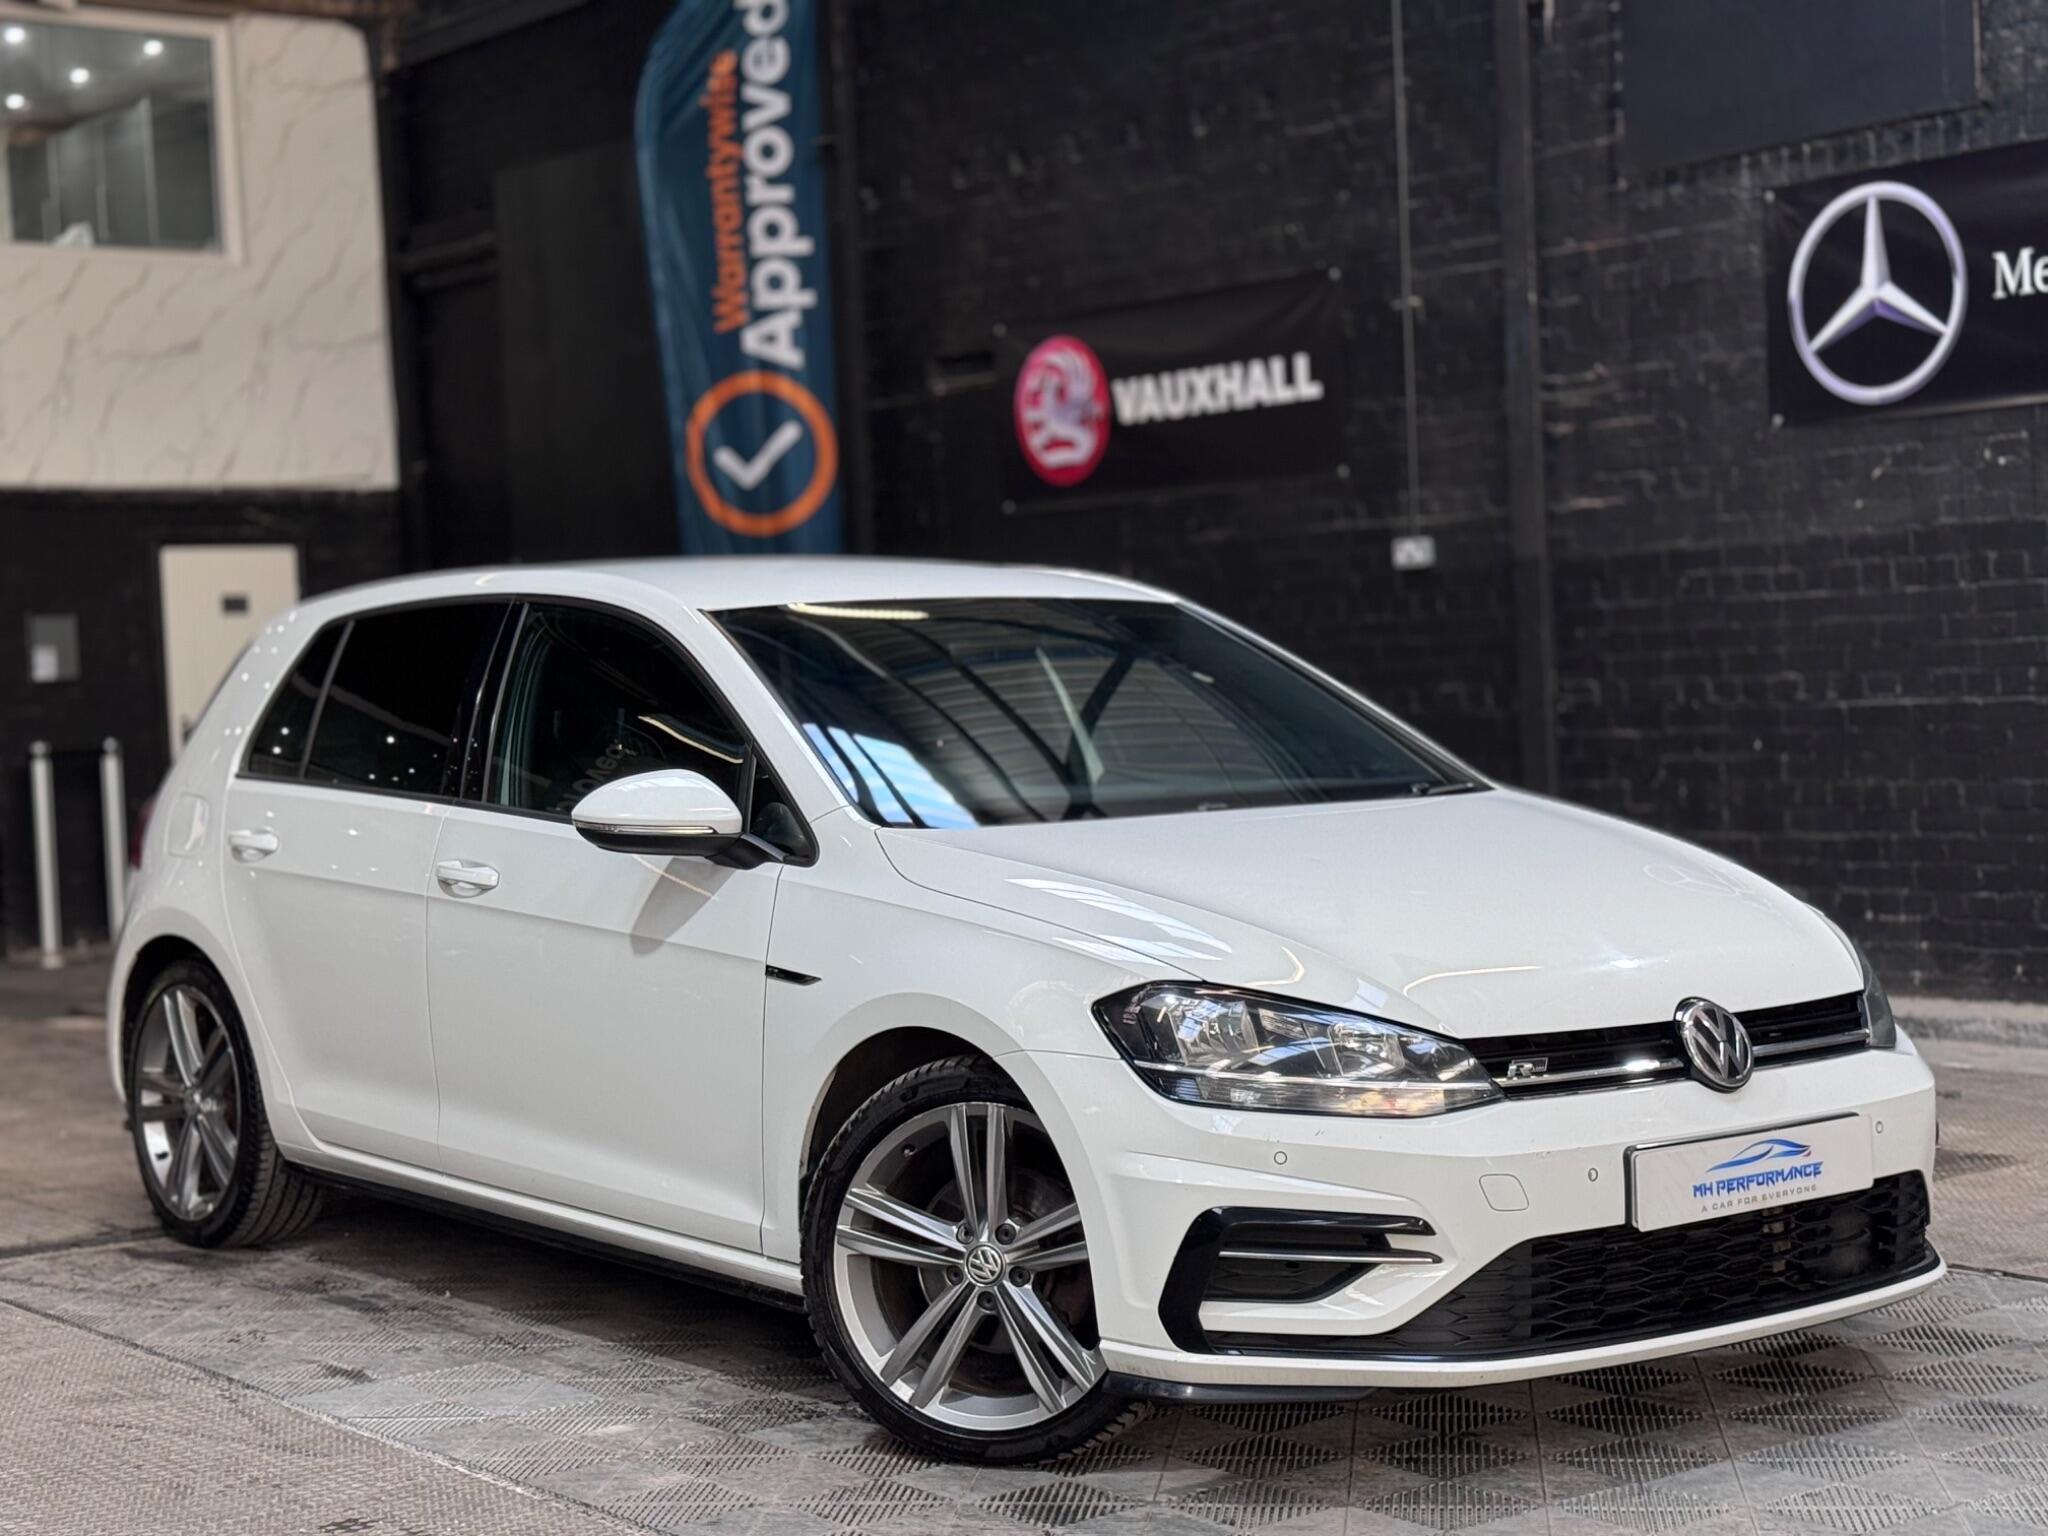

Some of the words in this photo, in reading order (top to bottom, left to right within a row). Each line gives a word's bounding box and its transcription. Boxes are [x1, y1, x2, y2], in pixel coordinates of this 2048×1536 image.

[702, 50, 752, 333] Warrantywise
[736, 0, 817, 368] Approved
[1111, 352, 1324, 425] VAUXHALL
[1693, 1182, 1713, 1198] MH
[1716, 1161, 1823, 1195] PERFORMANCE
[1712, 1201, 1733, 1210] CAR
[1737, 1196, 1758, 1206] FOR
[1761, 1184, 1817, 1201] EVERYONE
